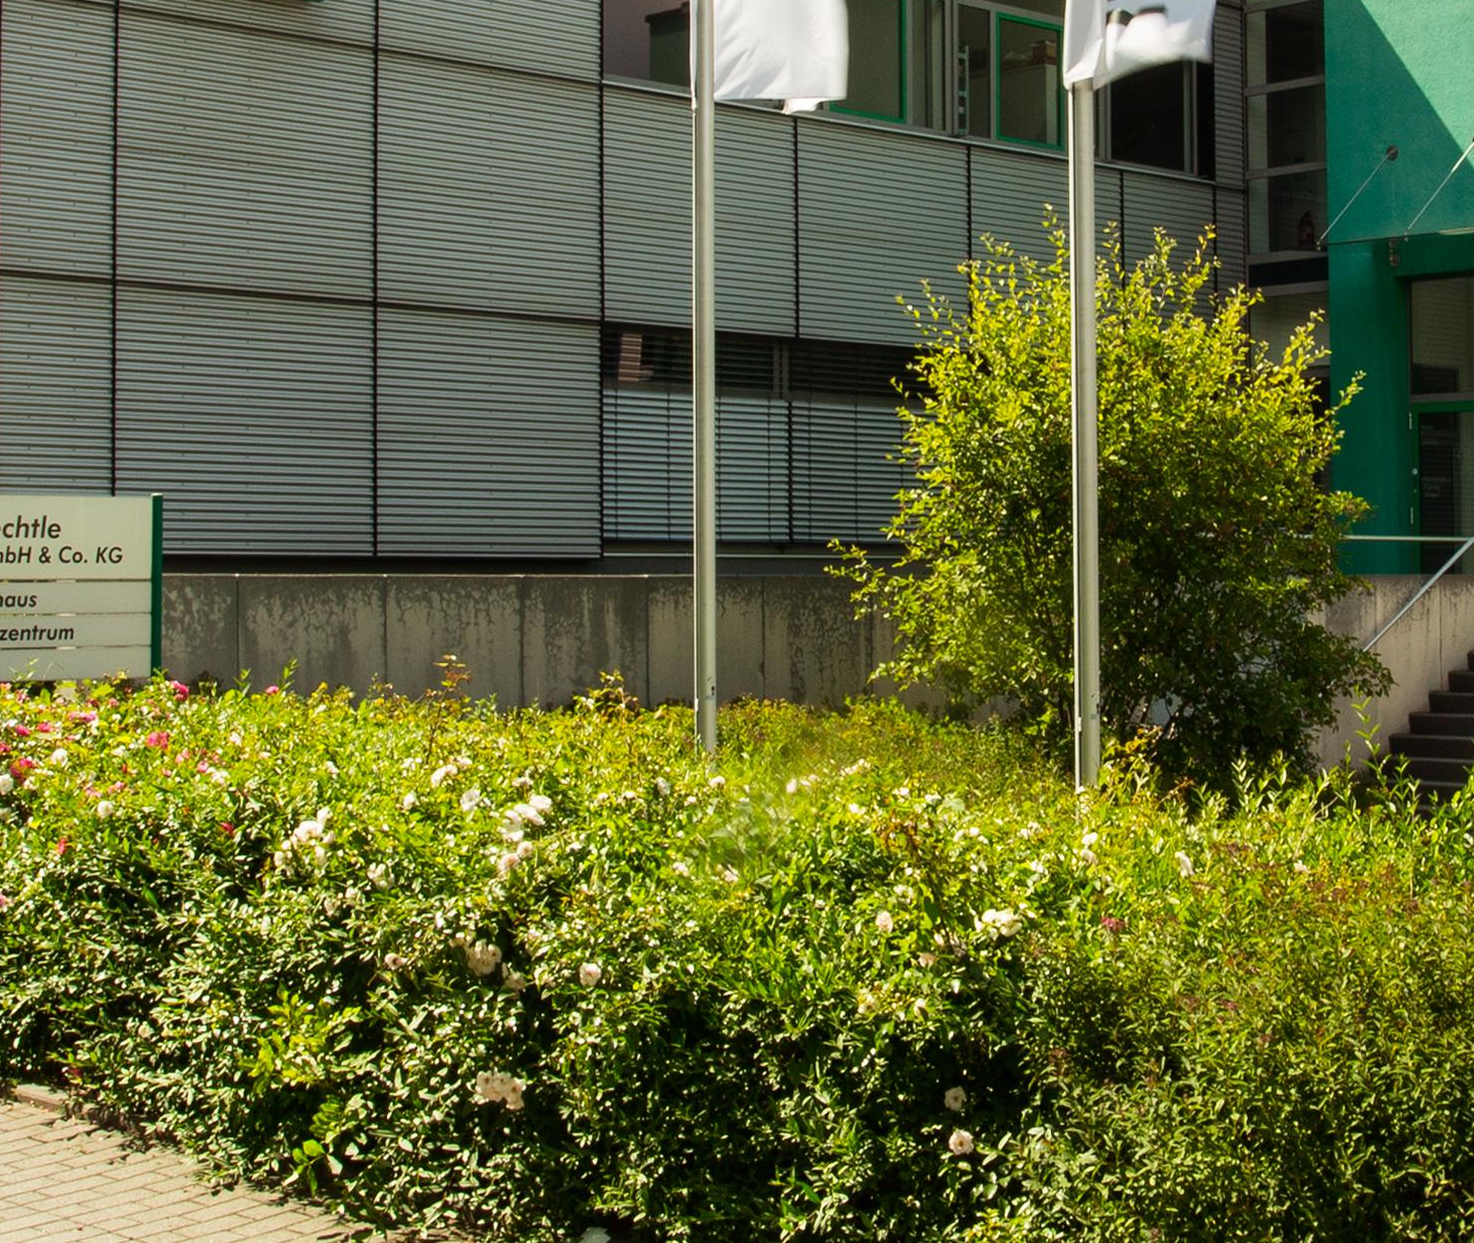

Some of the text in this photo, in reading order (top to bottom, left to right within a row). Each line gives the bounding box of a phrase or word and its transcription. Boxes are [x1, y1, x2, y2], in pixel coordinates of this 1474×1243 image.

[38, 547, 52, 564] &
[58, 546, 88, 565] Co.
[95, 546, 124, 564] KG
